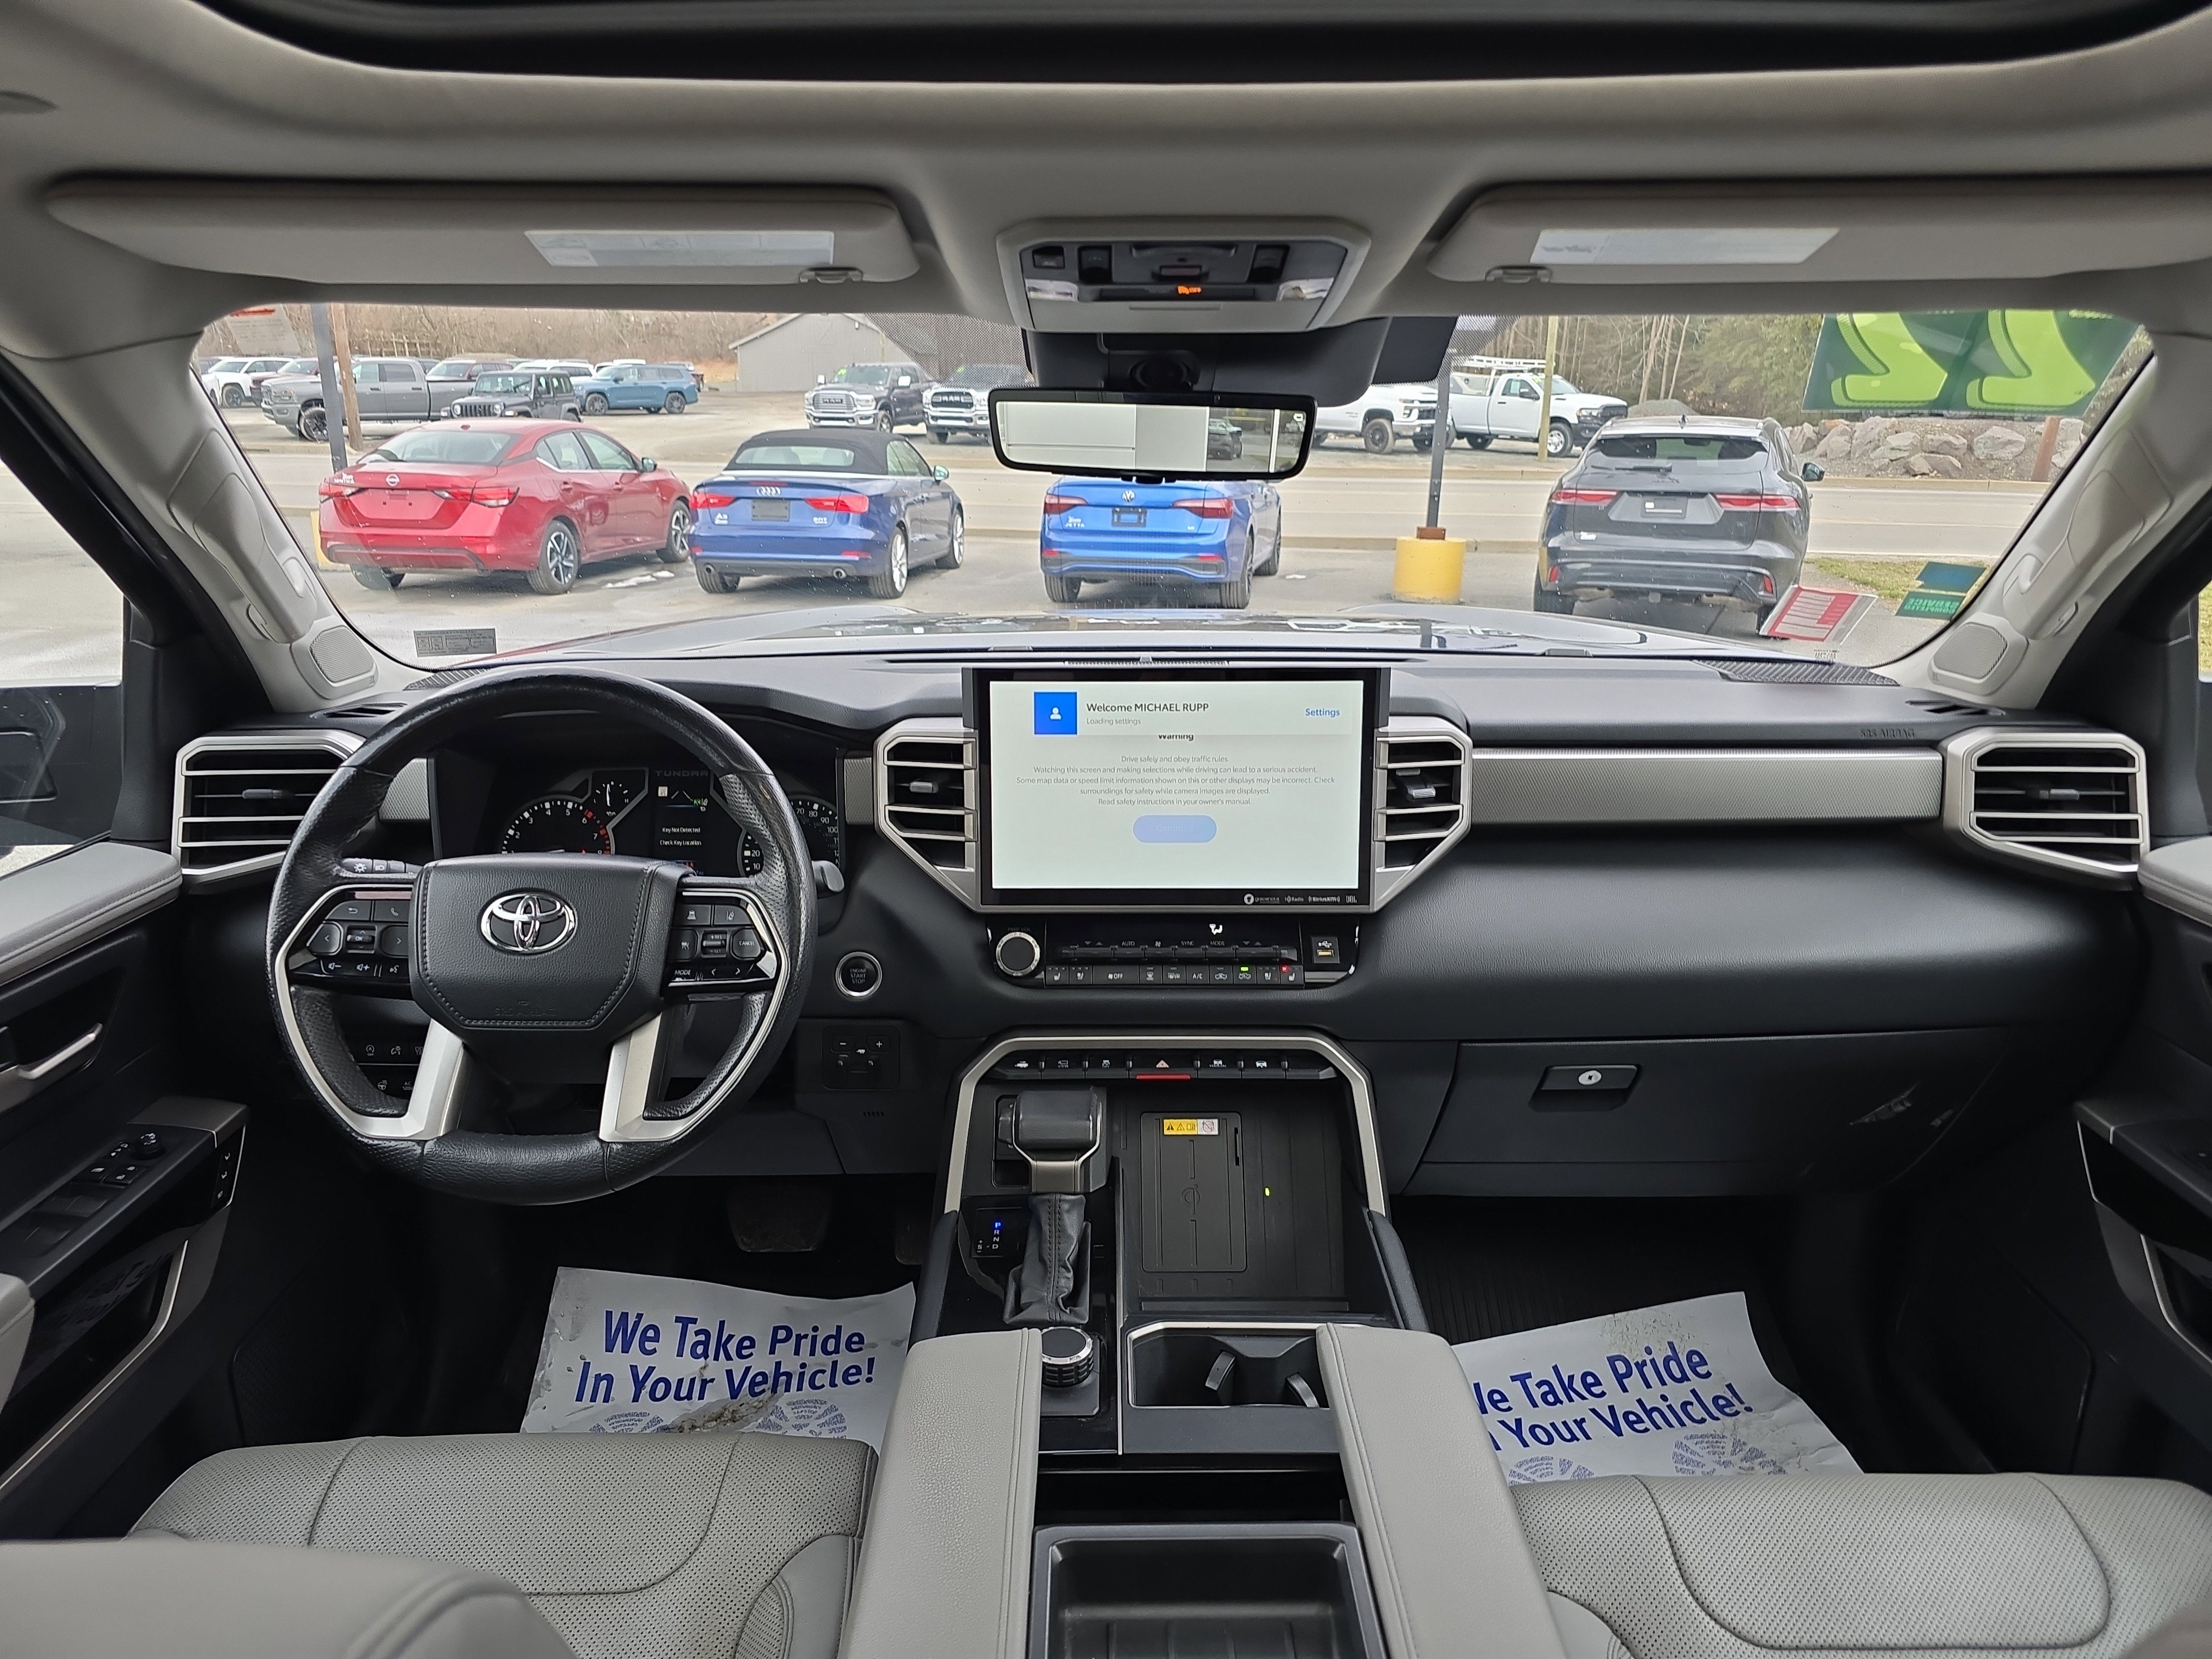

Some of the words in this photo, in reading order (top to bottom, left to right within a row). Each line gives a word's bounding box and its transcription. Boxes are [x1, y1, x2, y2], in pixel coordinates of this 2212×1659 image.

[1086, 703, 1132, 712] Welcome
[1134, 703, 1180, 712] MICHAEL
[1182, 703, 1209, 712] RUPP
[1305, 708, 1340, 718] Settings
[1016, 776, 1036, 785] Some
[1037, 776, 1052, 785] map
[1053, 776, 1069, 785] data
[1070, 776, 1077, 785] or
[1078, 776, 1098, 785] speed
[1099, 776, 1115, 785] limit
[1116, 776, 1154, 785] information
[1155, 776, 1176, 785] shown
[1178, 776, 1187, 785] on
[1188, 776, 1199, 785] this
[1200, 776, 1208, 785] or
[1209, 776, 1227, 785] other
[1228, 776, 1255, 785] displays
[1256, 776, 1271, 785] may
[1271, 776, 1280, 785] be
[1282, 776, 1313, 785] incorrect.
[1314, 776, 1335, 785] Check
[1080, 787, 1123, 795] surroundings
[1124, 787, 1134, 795] for
[1135, 787, 1154, 795] safety
[1155, 787, 1173, 795] while
[1174, 787, 1198, 795] camera
[1199, 787, 1224, 795] images
[1225, 787, 1236, 795] are
[1237, 787, 1270, 795] displayed.
[605, 1310, 661, 1355] We
[674, 1316, 757, 1362] Take
[768, 1324, 866, 1358] Pride
[574, 1361, 614, 1403] In
[628, 1364, 716, 1403] Your
[725, 1357, 876, 1400] Vehicle!
[1509, 1364, 1607, 1409] Take
[1606, 1340, 1713, 1393] Pride
[1497, 1415, 1592, 1448] Your
[1588, 1382, 1753, 1438] Vehicle!
